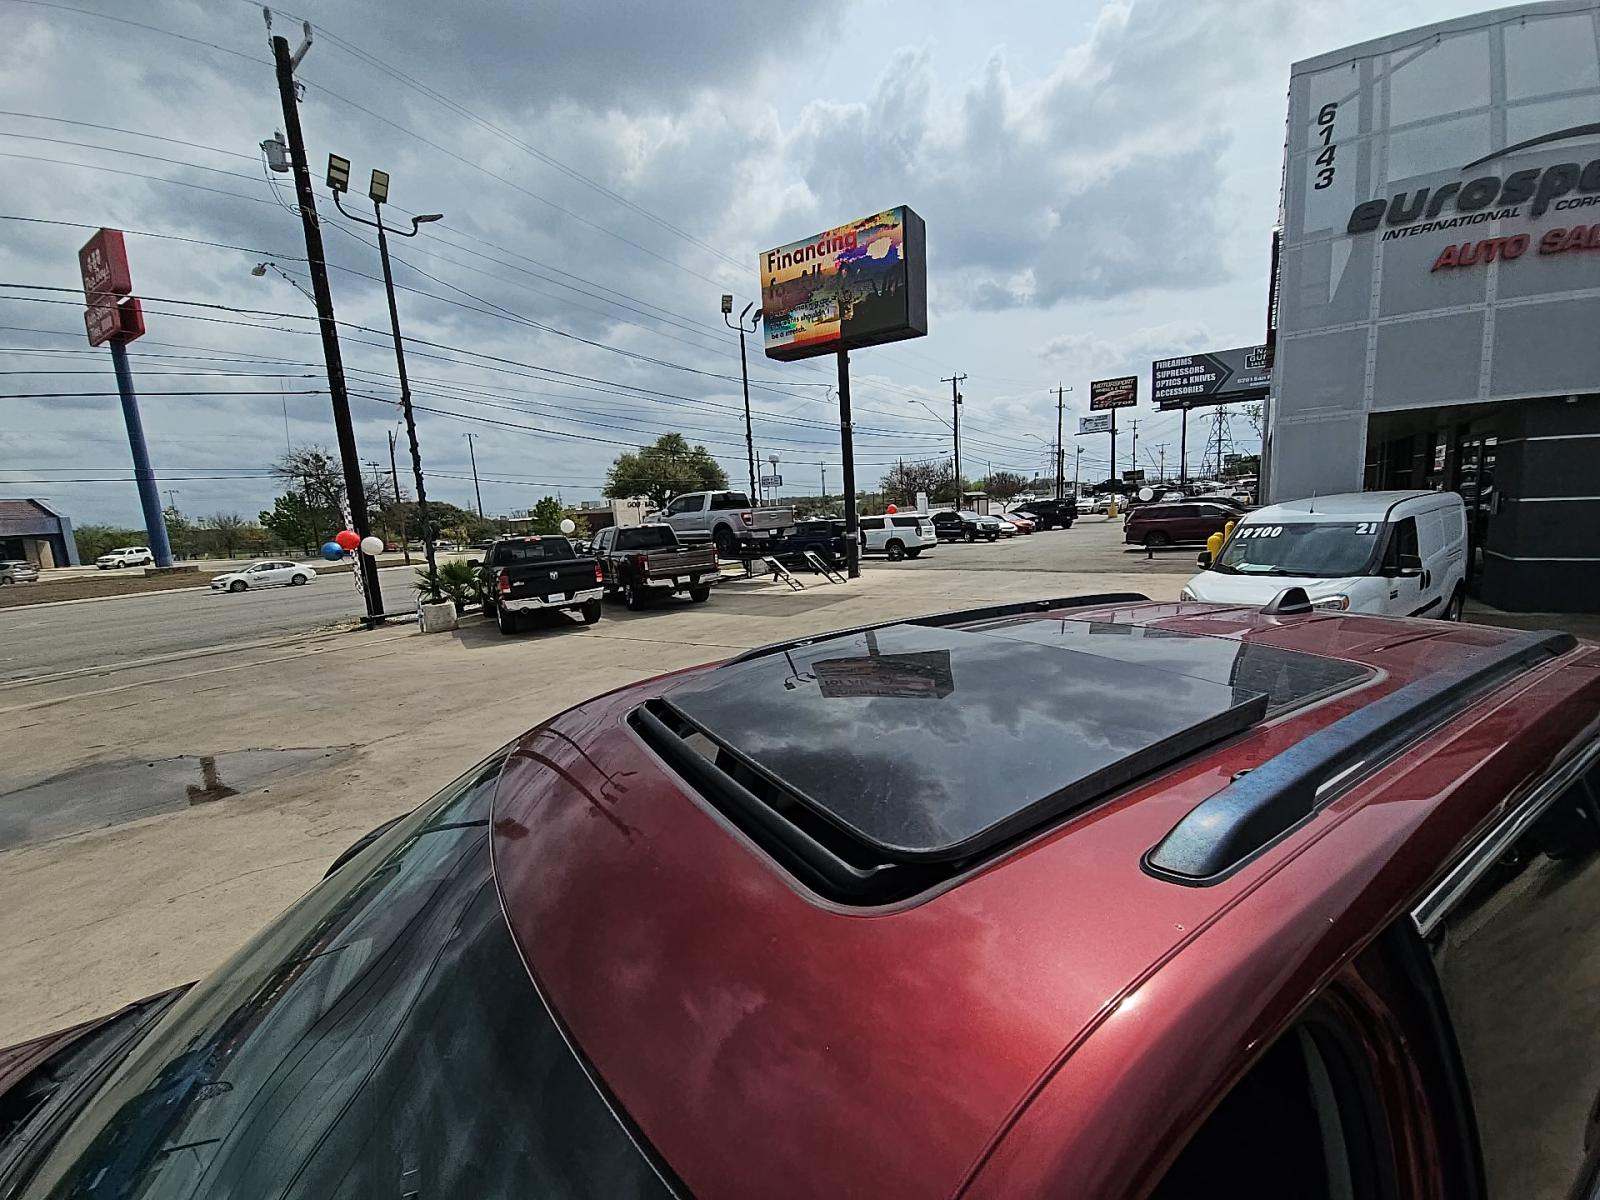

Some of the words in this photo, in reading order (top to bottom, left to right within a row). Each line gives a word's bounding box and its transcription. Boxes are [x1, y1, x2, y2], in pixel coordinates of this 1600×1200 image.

[1314, 102, 1338, 190] 6143
[1382, 207, 1521, 242] INTERNATIONAL
[767, 230, 858, 274] Financing
[1431, 234, 1531, 273] AUTO
[1156, 357, 1192, 369] FIREARMS
[1156, 365, 1205, 379] SUPRESSORS
[1156, 377, 1181, 388] OPTICS
[1190, 373, 1216, 383] KNIVES
[1155, 385, 1204, 397] ACCESSORIES
[1235, 526, 1283, 539] 19700
[1356, 522, 1377, 535] 21
